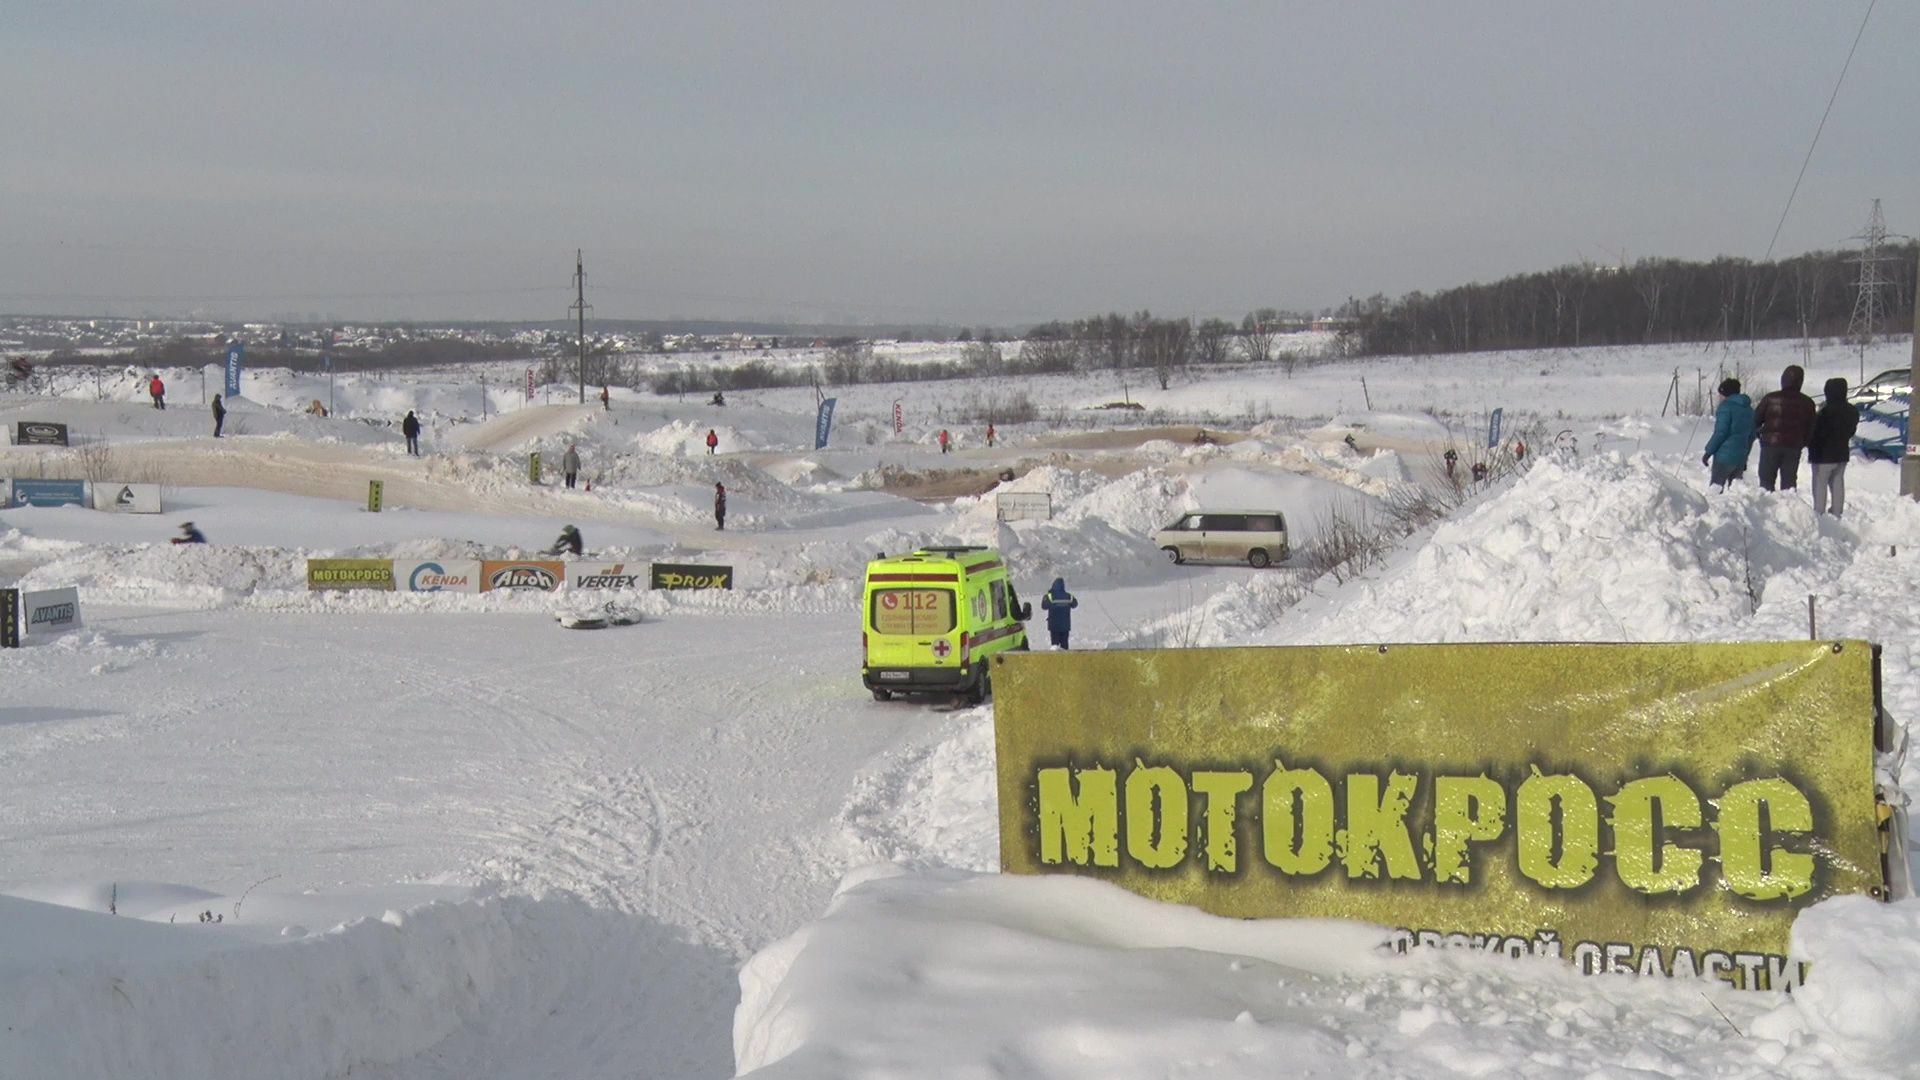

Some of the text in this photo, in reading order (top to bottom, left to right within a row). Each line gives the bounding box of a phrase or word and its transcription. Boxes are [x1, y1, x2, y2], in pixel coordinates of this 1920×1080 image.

[313, 568, 390, 581] МОТОКРОСС
[421, 575, 468, 586] KENDA
[495, 571, 552, 587] Airoh
[577, 574, 638, 589] VERTEX
[902, 592, 938, 610] 112
[31, 602, 74, 624] AVANTIS
[1038, 759, 1815, 902] МОТОКРОСС
